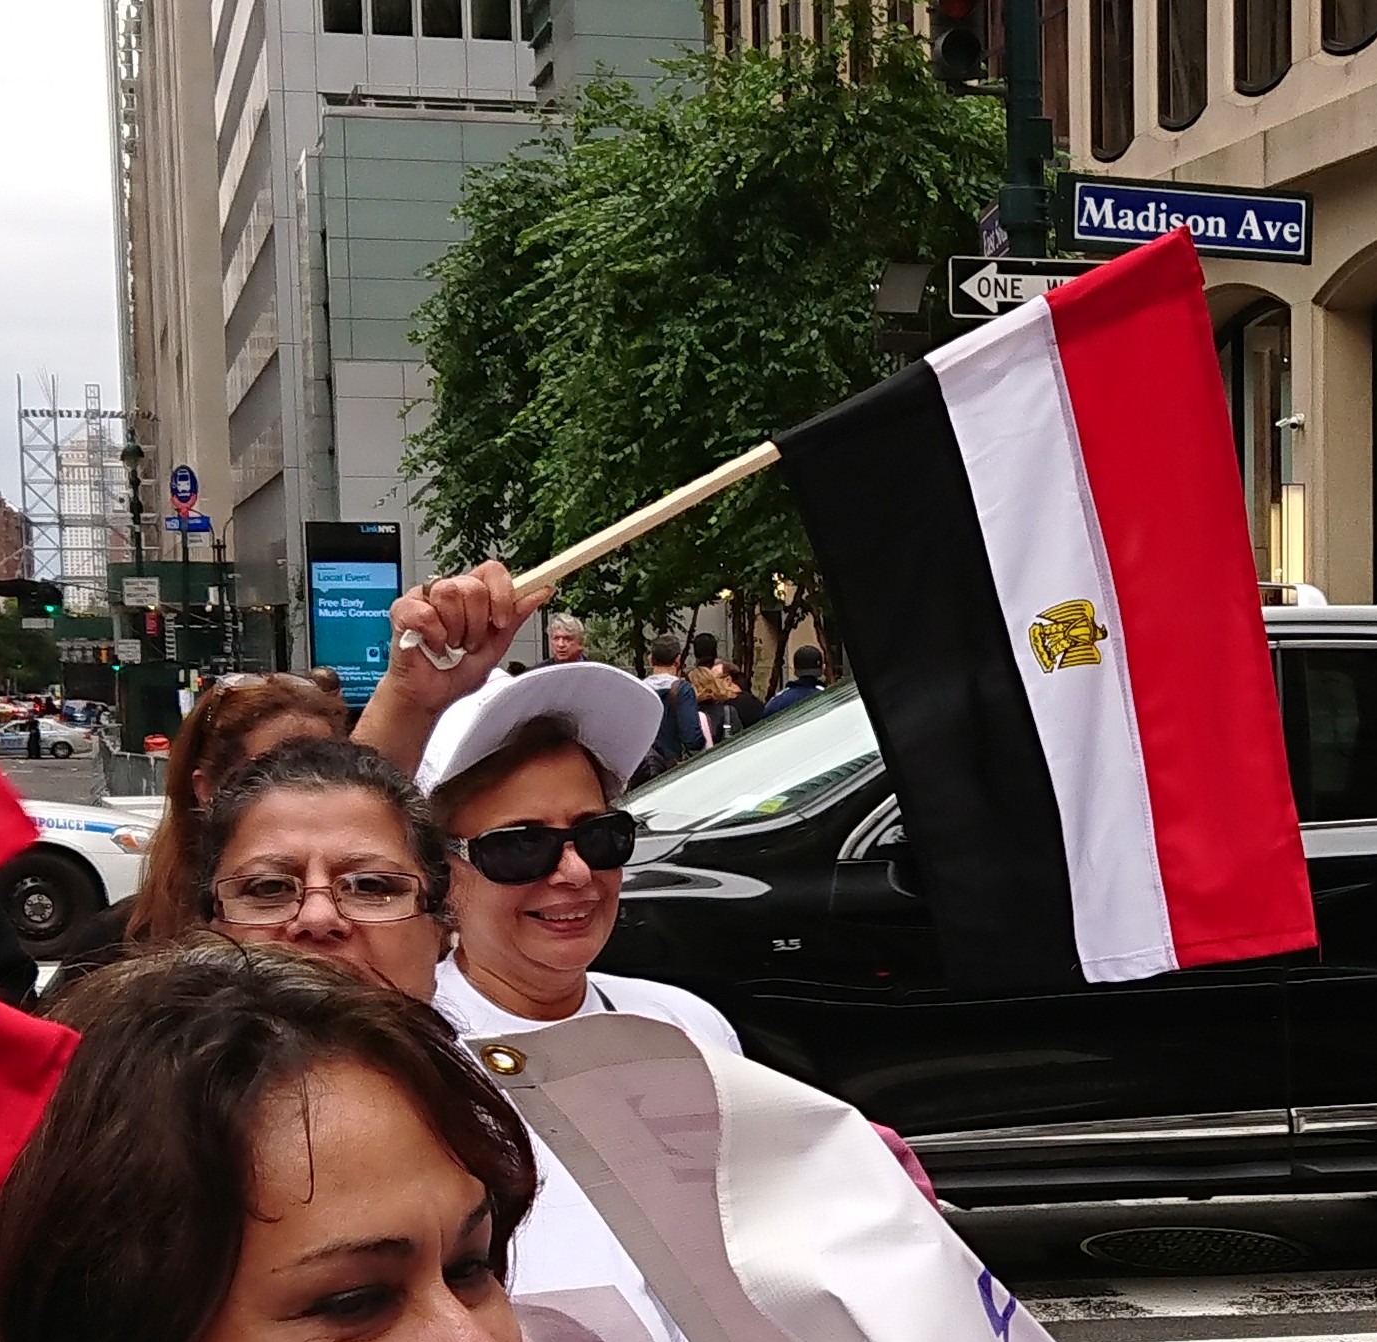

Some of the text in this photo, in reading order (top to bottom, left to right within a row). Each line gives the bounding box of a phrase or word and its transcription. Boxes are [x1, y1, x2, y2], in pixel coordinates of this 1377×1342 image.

[1079, 196, 1301, 244] Madison Ave
[976, 275, 1024, 300] ONE
[317, 573, 371, 583] Local Event
[318, 598, 365, 609] Free Early
[318, 608, 347, 618] Music
